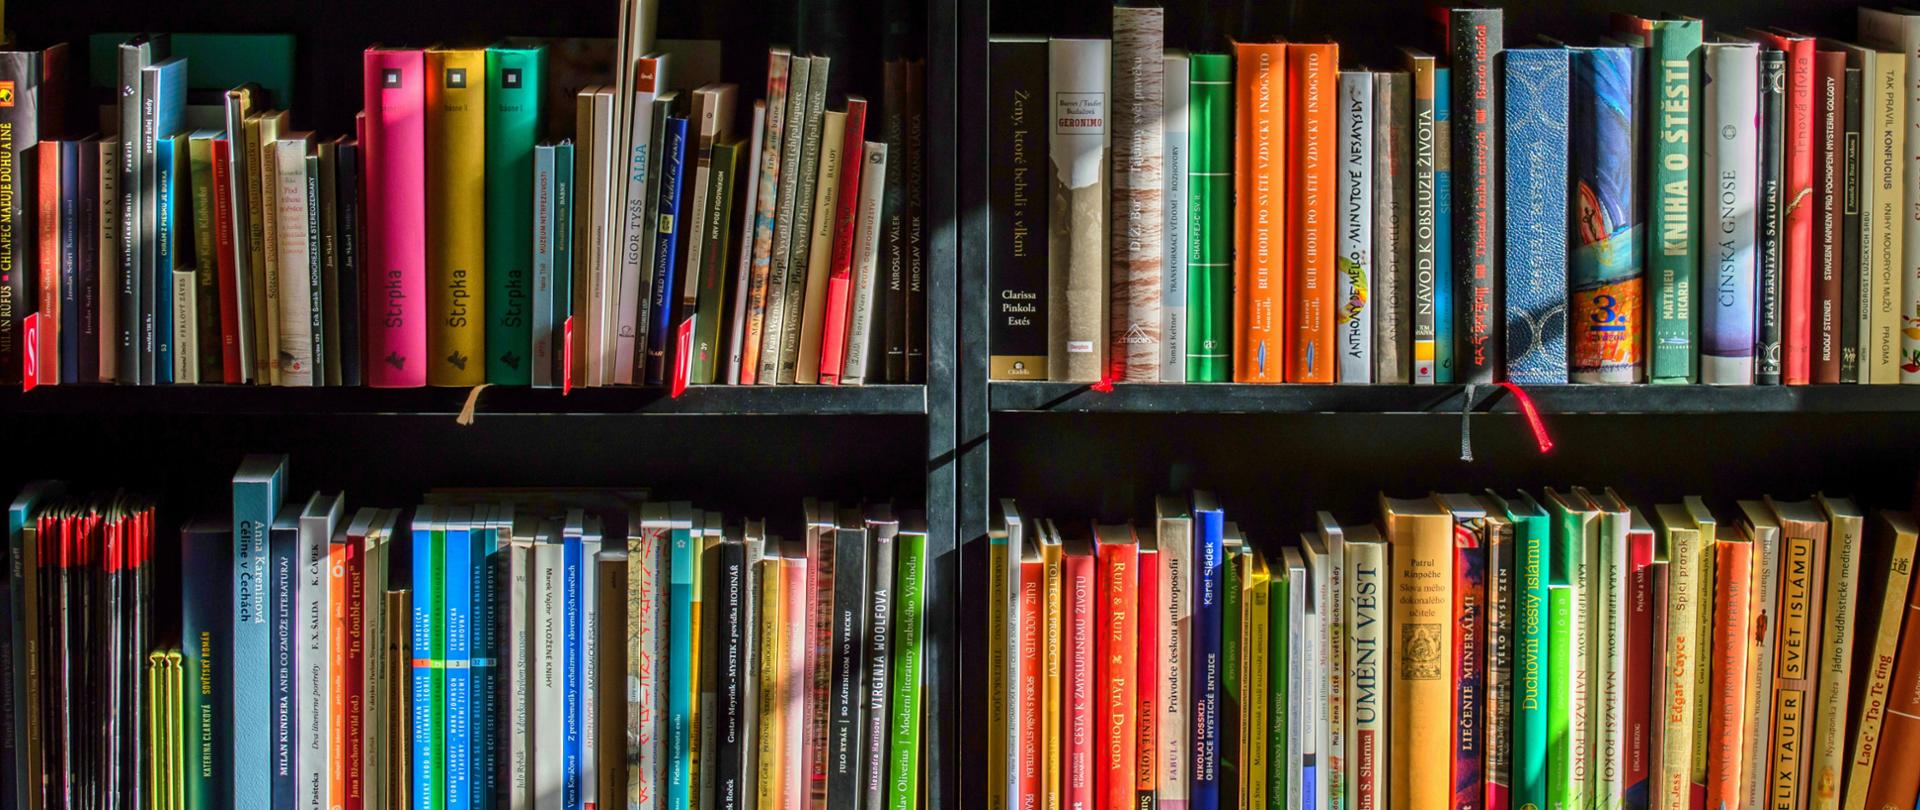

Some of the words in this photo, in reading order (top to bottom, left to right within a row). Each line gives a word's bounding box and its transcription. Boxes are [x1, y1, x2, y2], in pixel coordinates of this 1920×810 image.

[1259, 52, 1269, 113] INKOGNITO
[1308, 52, 1319, 113] INKOGNITO
[1475, 63, 1487, 99] Bardo
[1826, 76, 1835, 111] GOLGOTY
[1885, 69, 1895, 90] TAK
[1661, 59, 1690, 144] ŠTĚSTÍ
[1885, 92, 1895, 127] PRAVIL
[1059, 118, 1103, 127] GERONIMO
[1416, 108, 1432, 166] ŽIVOTA
[1825, 112, 1835, 150] MYSTERIA
[633, 143, 647, 184] ALBA
[1171, 144, 1179, 192] ROZHOVORY
[1665, 154, 1689, 171] O
[1883, 130, 1893, 191] KONFUCIUS
[713, 211, 721, 225] POD
[1419, 171, 1432, 238] OBSLUZE
[1664, 179, 1689, 256] KNIHA
[1721, 169, 1736, 234] GNOSE
[1765, 179, 1777, 237] SATURNI
[1825, 194, 1833, 210] PRO
[1882, 202, 1891, 231] KNIHY
[711, 226, 720, 240] KRV
[1824, 211, 1833, 244] KAMENY
[0, 224, 12, 271] CHLAPEC
[628, 234, 641, 266] IGOR
[1169, 232, 1178, 293] TRANSFORMACE
[1419, 241, 1432, 253] K
[890, 244, 901, 291] MIROSLAV
[911, 246, 921, 292] MIROSLAV
[1349, 251, 1361, 285] MELLO
[1415, 257, 1432, 315] NÁVOD
[1718, 240, 1736, 308] ČÍNSKÁ
[1764, 239, 1776, 327] FRATERNITAS
[1001, 289, 1037, 301] Clarissa
[1002, 303, 1036, 313] Pinkola
[1663, 268, 1674, 320] MATTHIEU
[1678, 281, 1688, 320] RICARD
[1862, 277, 1870, 320] MOUDROST
[1008, 316, 1031, 326] Estés
[1169, 312, 1177, 341] Keltner
[1823, 299, 1832, 331] STEINER
[1, 319, 12, 352] MILAN
[1822, 331, 1831, 361] RUDOLF
[1881, 326, 1890, 364] PRAGMA
[239, 520, 251, 558] Céline
[254, 520, 266, 552] Anna
[1204, 541, 1215, 576] Sládek
[1410, 559, 1435, 567] Patrul
[1521, 538, 1541, 591] islámu
[1677, 539, 1690, 578] prorok
[1839, 533, 1852, 579] meditace
[280, 556, 289, 618] LITERATURA?
[545, 568, 553, 591] Marek
[1203, 578, 1213, 605] Karel
[1498, 567, 1508, 592] ZEN
[1577, 563, 1586, 589] KARA
[1607, 564, 1617, 590] KARA
[1759, 569, 1770, 603] Sharma
[1788, 545, 1806, 619] ISLÁMU
[239, 572, 254, 622] Čechách
[1350, 561, 1377, 632] VÉST
[1497, 596, 1507, 630] MYSL
[1524, 593, 1542, 634] cesty
[350, 601, 361, 638] double
[280, 652, 289, 667] CO
[727, 644, 737, 677] MYSTIK
[1672, 634, 1687, 678] Cayce
[1783, 627, 1800, 673] SVĚT
[280, 667, 289, 692] ANEB
[545, 661, 553, 688] KNIHY
[871, 655, 885, 710] VIRGINIA
[901, 648, 914, 692] literatury
[1207, 652, 1216, 691] INTUICE
[1350, 636, 1376, 727] UMĚNÍ
[1521, 638, 1539, 711] Duchovní
[1871, 681, 1884, 696] Te
[350, 694, 361, 714] (ed.)
[728, 683, 738, 716] Meyrink
[839, 753, 847, 773] JULO
[844, 610, 852, 643] VRECKU
[1075, 702, 1084, 710] K
[1671, 681, 1686, 723] Edgar
[1865, 699, 1882, 721] Tao
[279, 695, 289, 742] KUNDERA
[567, 688, 577, 735] problematiky
[727, 716, 736, 743] Gustav
[899, 693, 911, 736] Moderní
[1074, 714, 1085, 745] CESTA
[1141, 700, 1151, 745] UMENIE
[1197, 699, 1206, 740] LOSSKIJ:
[1460, 685, 1474, 751] LIEČENIE
[1778, 698, 1797, 762] TAUER
[279, 744, 289, 776] MILAN
[311, 733, 320, 750] Dva
[673, 730, 681, 759] hodnota
[1169, 739, 1177, 781] FABULA
[1361, 734, 1372, 778] Sharma
[1574, 738, 1585, 783] POKOJ
[1604, 738, 1615, 783] POKOJ
[1857, 744, 1873, 767] Lao
[870, 753, 880, 791] Alexandra
[897, 749, 909, 792] Oliverius
[1140, 748, 1151, 783] VOJNY
[1196, 741, 1205, 781] NIKOLAJ
[350, 779, 361, 798] Jana
[567, 789, 576, 808] Viera
[725, 778, 734, 801] Roček
[1361, 780, 1372, 791] S.
[1670, 773, 1681, 797] Jess
